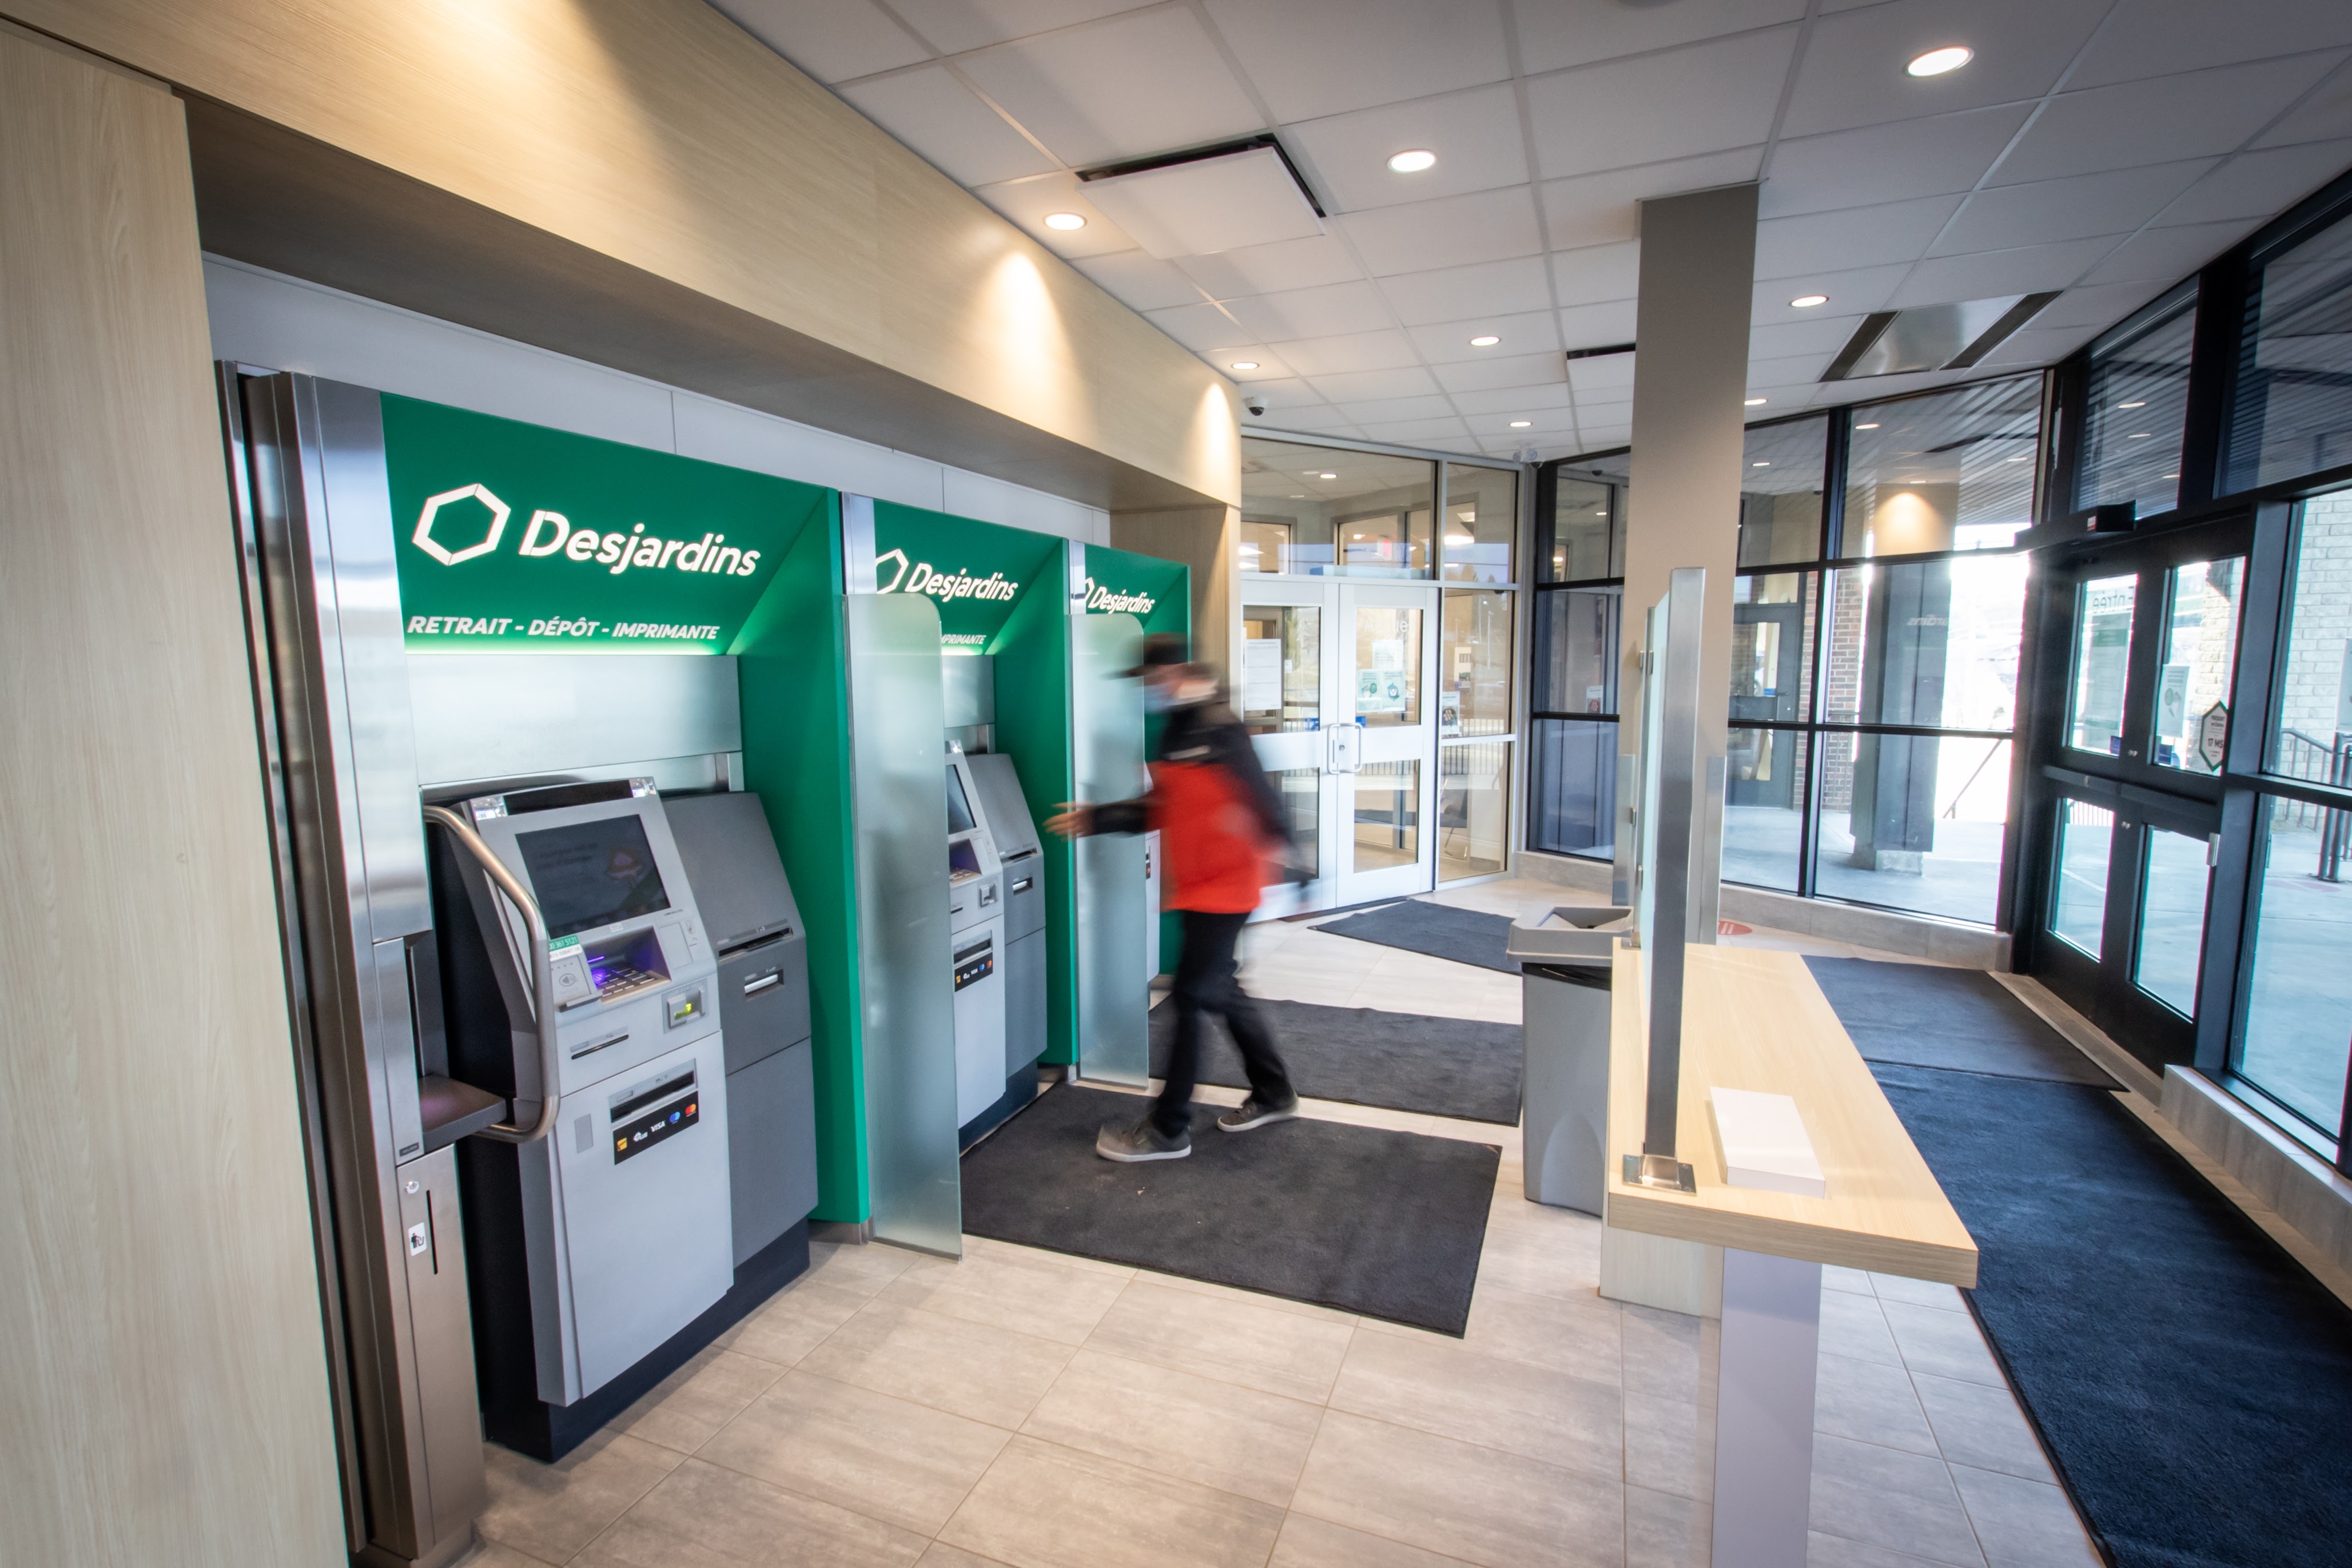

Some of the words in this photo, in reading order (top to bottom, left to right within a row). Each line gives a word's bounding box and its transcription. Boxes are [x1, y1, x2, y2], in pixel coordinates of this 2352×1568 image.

[519, 510, 761, 576] Desjardins
[904, 563, 1018, 602] Desjardins
[1088, 586, 1155, 614] Desjardins
[407, 616, 512, 634] RETRAIT
[527, 616, 600, 636] DÉPÔT
[612, 622, 720, 639] IMPRIMANTE
[941, 634, 986, 644] MPRIMANTE
[651, 1121, 665, 1132] VISA
